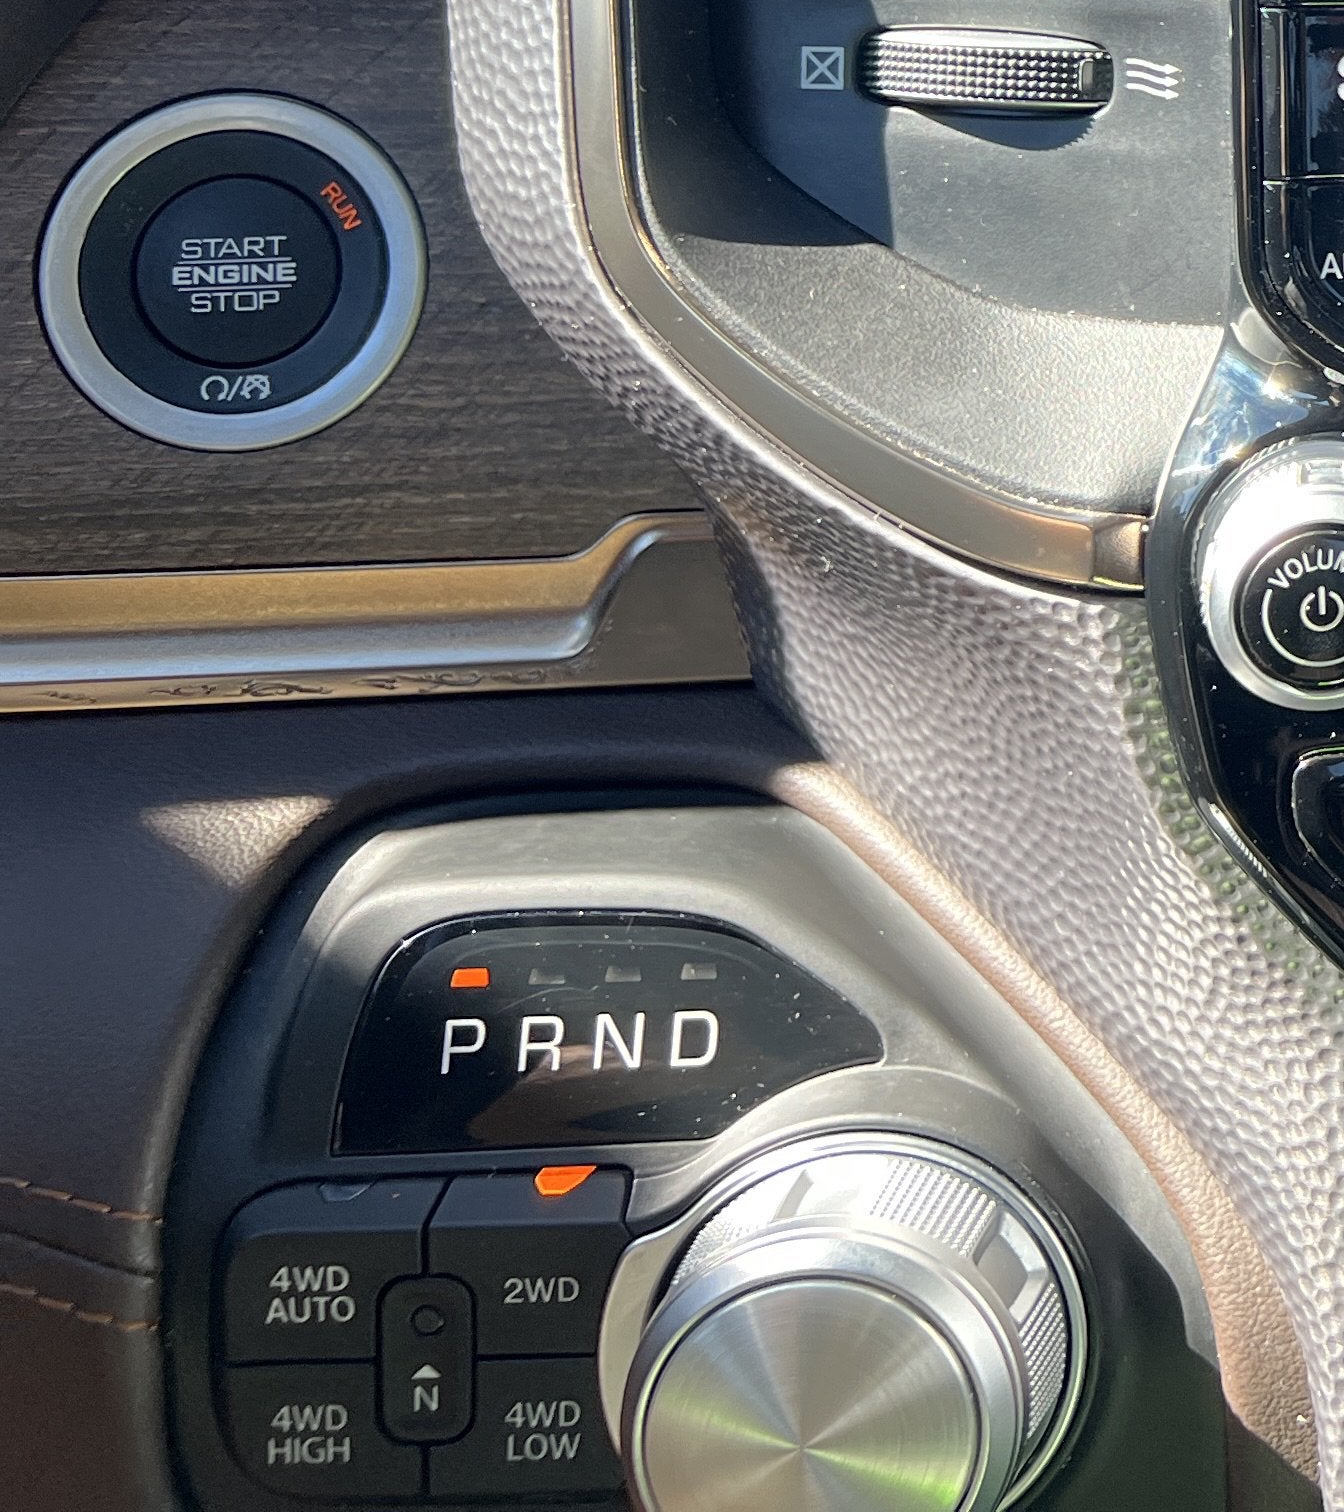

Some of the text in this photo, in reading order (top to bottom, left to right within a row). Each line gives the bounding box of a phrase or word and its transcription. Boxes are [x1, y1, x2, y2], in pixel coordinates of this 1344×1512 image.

[320, 181, 362, 231] RUN
[181, 235, 287, 260] START
[172, 261, 297, 287] ENGINE
[190, 289, 280, 314] STOP
[269, 1265, 350, 1293] 4WD
[503, 1276, 580, 1304] 2WD
[264, 1295, 356, 1324] AUTO
[412, 1384, 440, 1413] N
[270, 1404, 349, 1432] 4WD
[504, 1399, 582, 1428] 4WD
[267, 1435, 351, 1466] HIGH
[505, 1432, 582, 1462] LOW
